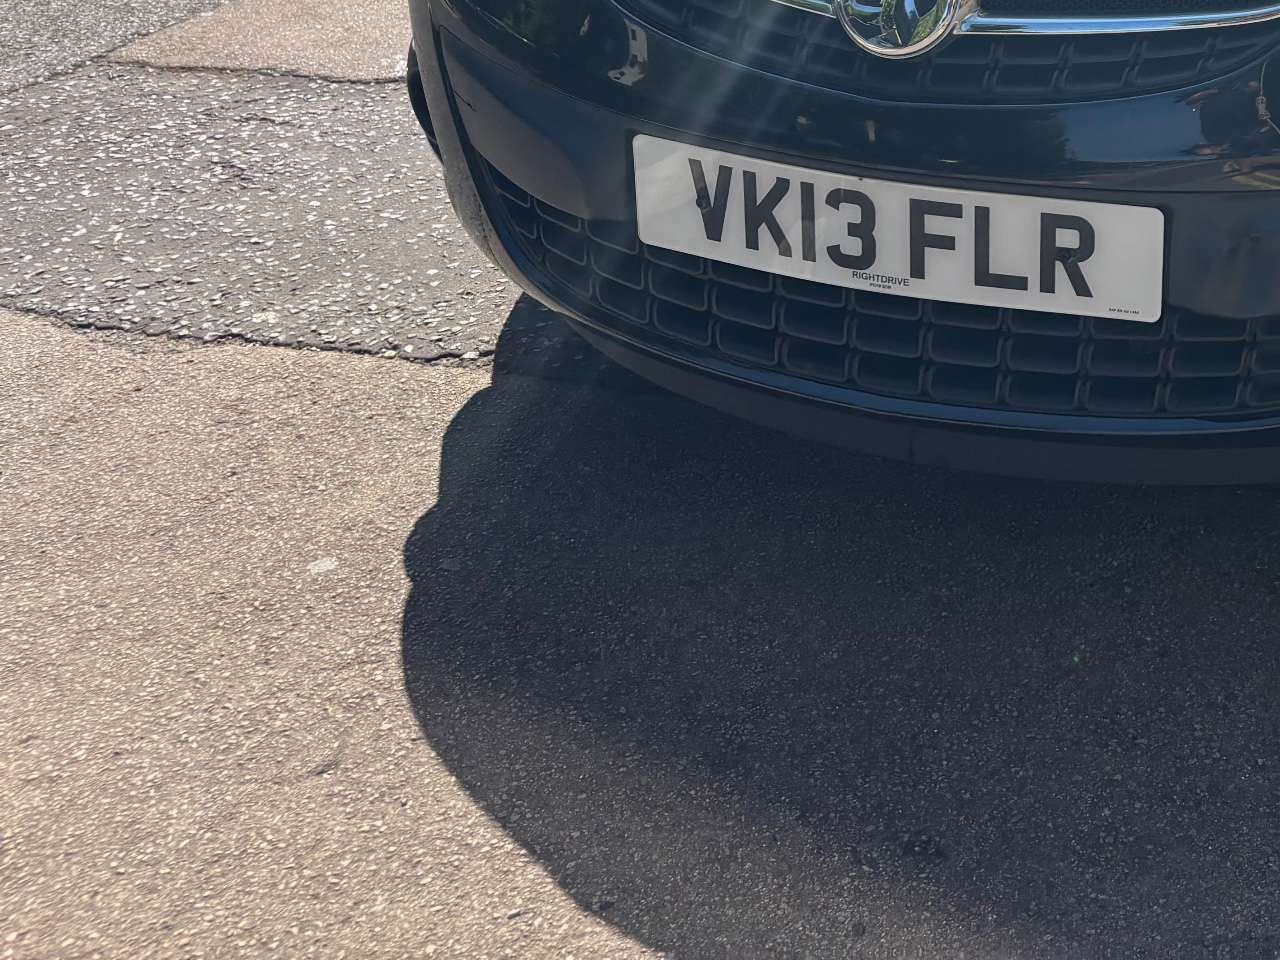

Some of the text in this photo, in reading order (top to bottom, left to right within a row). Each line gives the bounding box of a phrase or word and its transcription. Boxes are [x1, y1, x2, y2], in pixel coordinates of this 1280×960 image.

[688, 158, 1096, 298] VK13 FLR
[852, 270, 910, 287] RIGHTDRIVE
